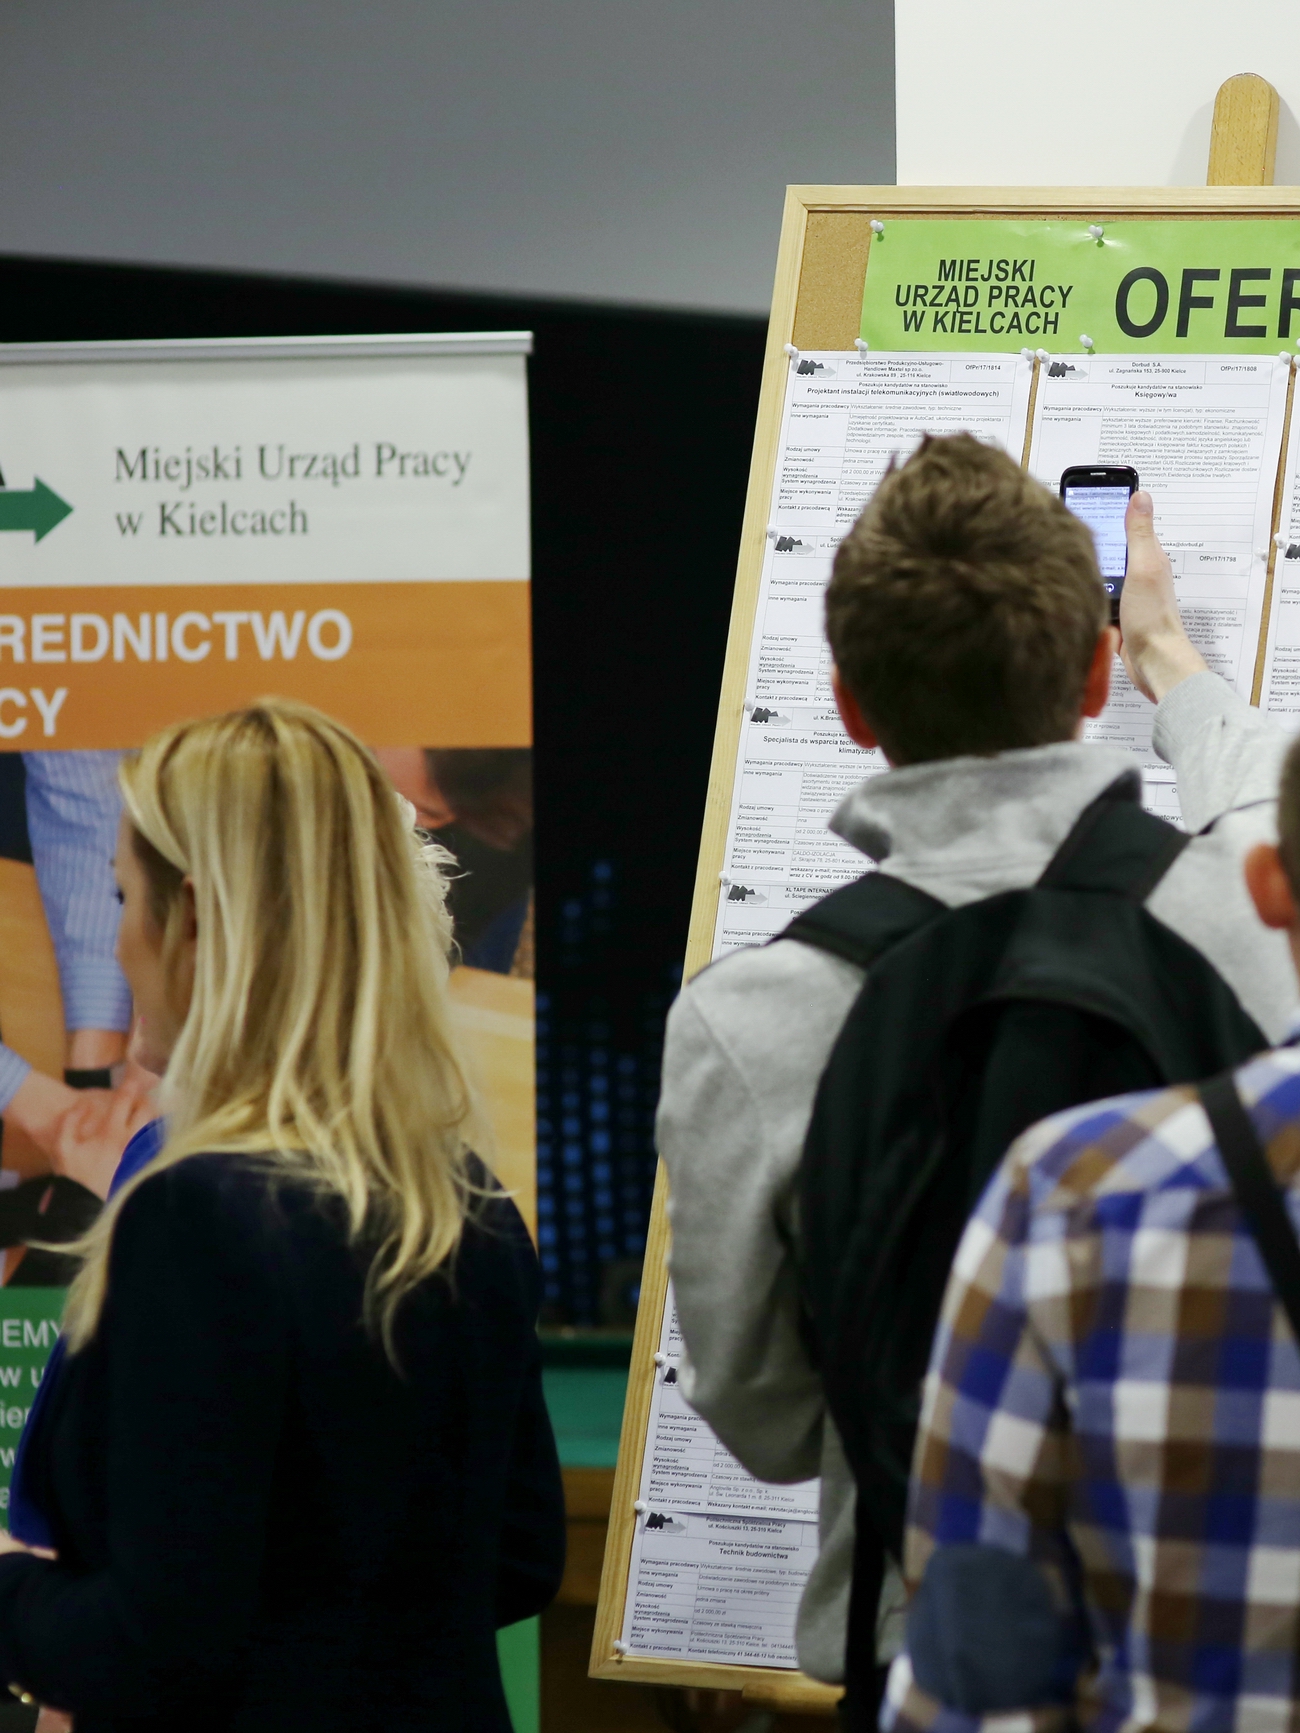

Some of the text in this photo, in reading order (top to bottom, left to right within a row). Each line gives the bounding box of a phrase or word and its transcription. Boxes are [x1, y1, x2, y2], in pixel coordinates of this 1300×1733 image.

[937, 259, 1035, 282] MIEJSKI
[895, 284, 1074, 313] URZĄD PRACY
[903, 310, 1059, 334] W KIELCACH
[807, 387, 840, 395] Projektant
[840, 388, 870, 396] instalacji
[870, 389, 938, 397] telekomunikacyjnych
[1134, 391, 1177, 399] Księgowy/wa
[114, 442, 472, 490] Miejski Urząd Pracy
[115, 501, 310, 536] w Kielcach
[763, 735, 799, 745] Specjalista
[838, 747, 876, 755] klimatyzacji
[719, 1547, 789, 1560] Technik budownictwa
